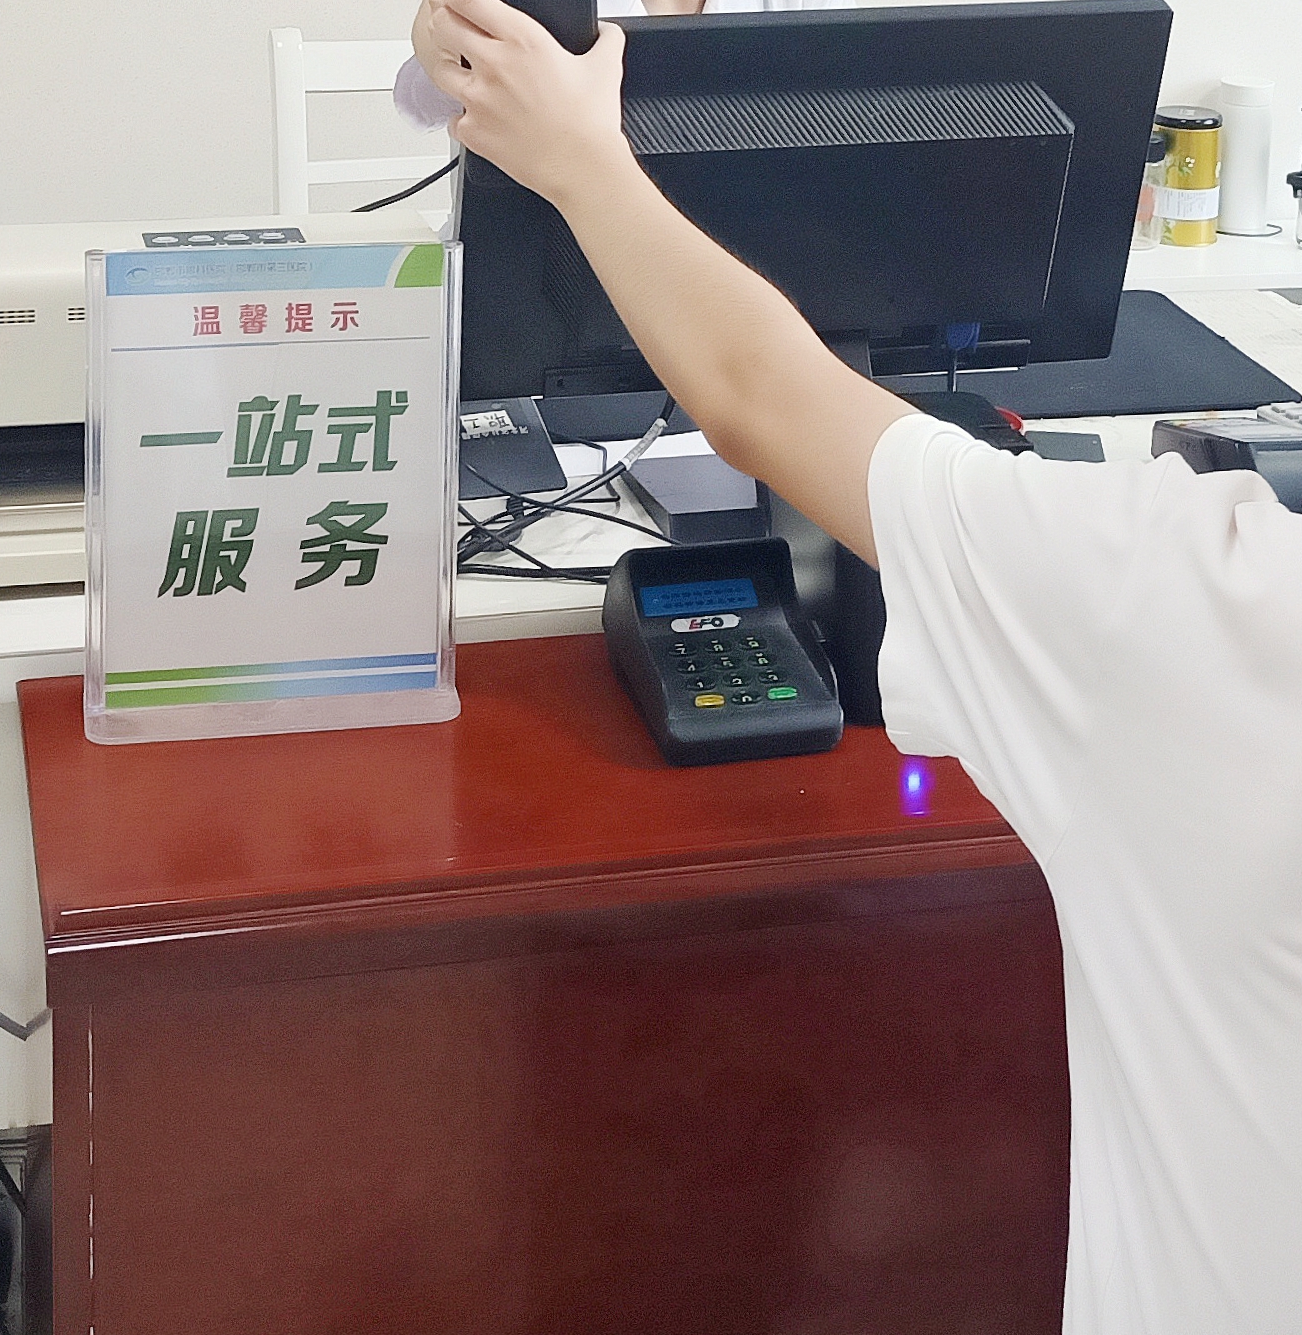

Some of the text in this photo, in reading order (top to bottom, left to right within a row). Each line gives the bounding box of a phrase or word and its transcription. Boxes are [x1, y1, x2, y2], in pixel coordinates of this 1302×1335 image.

[192, 300, 361, 337] 温馨提示
[139, 388, 410, 479] 一站式
[157, 499, 390, 599] 服务
